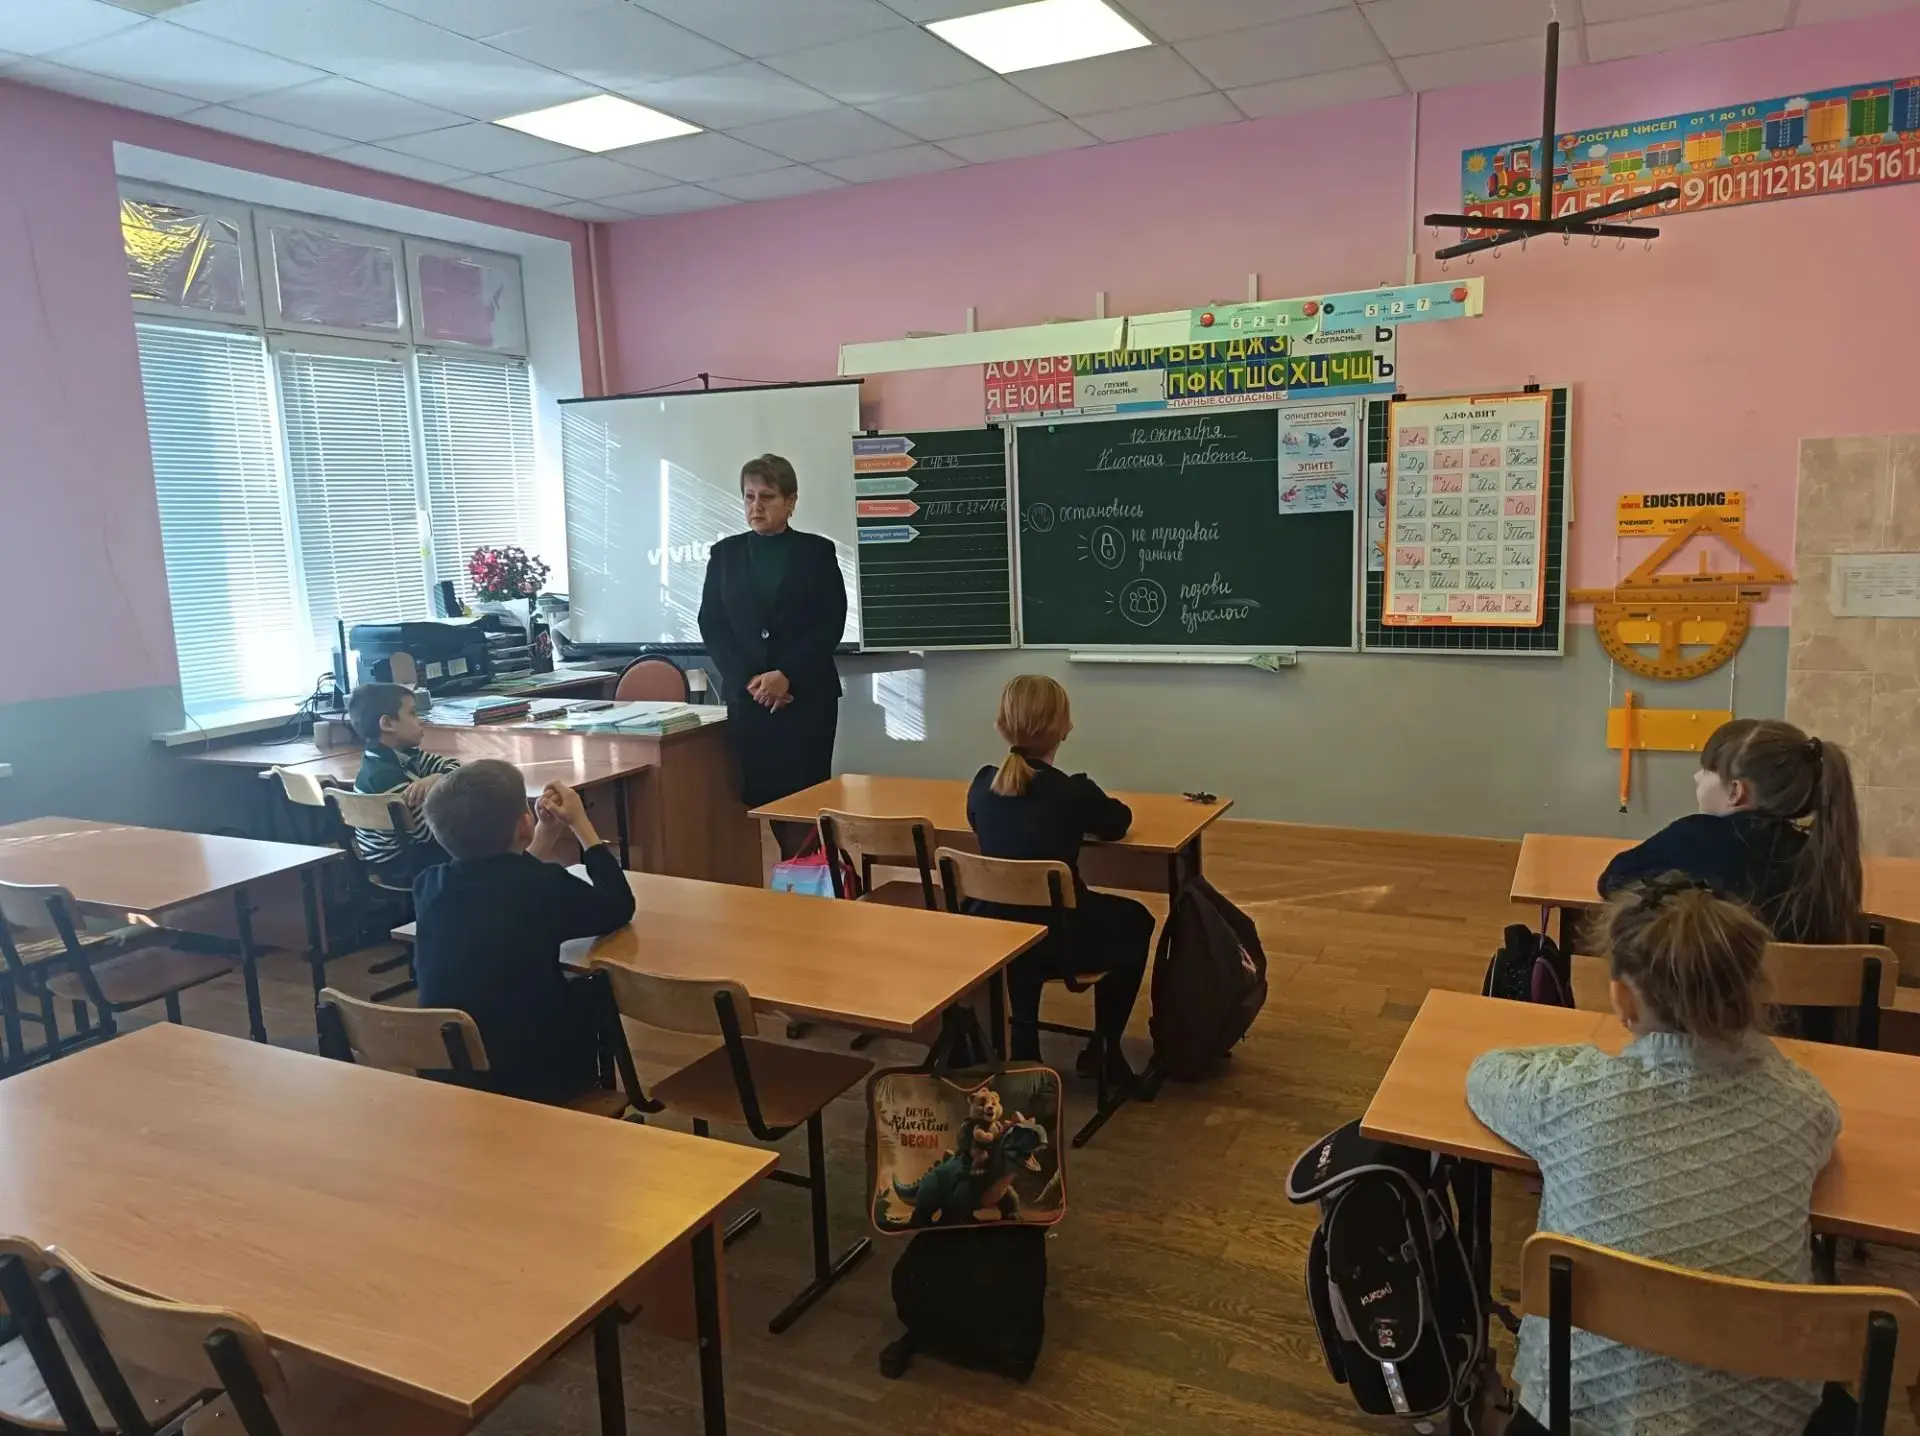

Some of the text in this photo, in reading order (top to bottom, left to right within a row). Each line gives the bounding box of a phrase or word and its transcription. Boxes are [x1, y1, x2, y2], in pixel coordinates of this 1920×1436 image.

[1578, 107, 1756, 144] СОСТАВ ЧИСЕЛ от 1 до 10
[1559, 196, 1579, 218] 4
[1684, 178, 1705, 206] 9
[1708, 174, 1734, 203] 10
[1736, 170, 1760, 199] 11
[1762, 165, 1788, 195] 12
[1791, 161, 1816, 191] 13
[1818, 157, 1845, 187] 14
[1848, 153, 1873, 182] 15
[1875, 150, 1902, 179] 16
[1369, 305, 1376, 316] 5
[1394, 303, 1401, 313] 2
[1420, 299, 1427, 310] 7
[1233, 318, 1239, 328] 6
[1255, 316, 1262, 327] 2
[1314, 333, 1363, 345] СОГЛАСНЫЕ
[1096, 387, 1138, 397] СОГЛАСНЫЕ
[1173, 392, 1282, 408] ПАРНЫЕ СОГЛАСНЫЕ
[1284, 409, 1347, 421] ОЛИЦЕТВОРЕНИЕ
[1442, 409, 1497, 421] АЛФАВИТ
[1096, 448, 1166, 471] Классная
[1296, 461, 1334, 472] ЭПИТЕТ
[1642, 491, 1726, 509] EDUSTRONG
[1059, 497, 1144, 522] остановись
[1131, 520, 1220, 549] не передавай
[1138, 548, 1184, 572] данные
[1180, 571, 1233, 608] позови
[1180, 604, 1250, 634] взрослого
[900, 1133, 939, 1149] BEGIN
